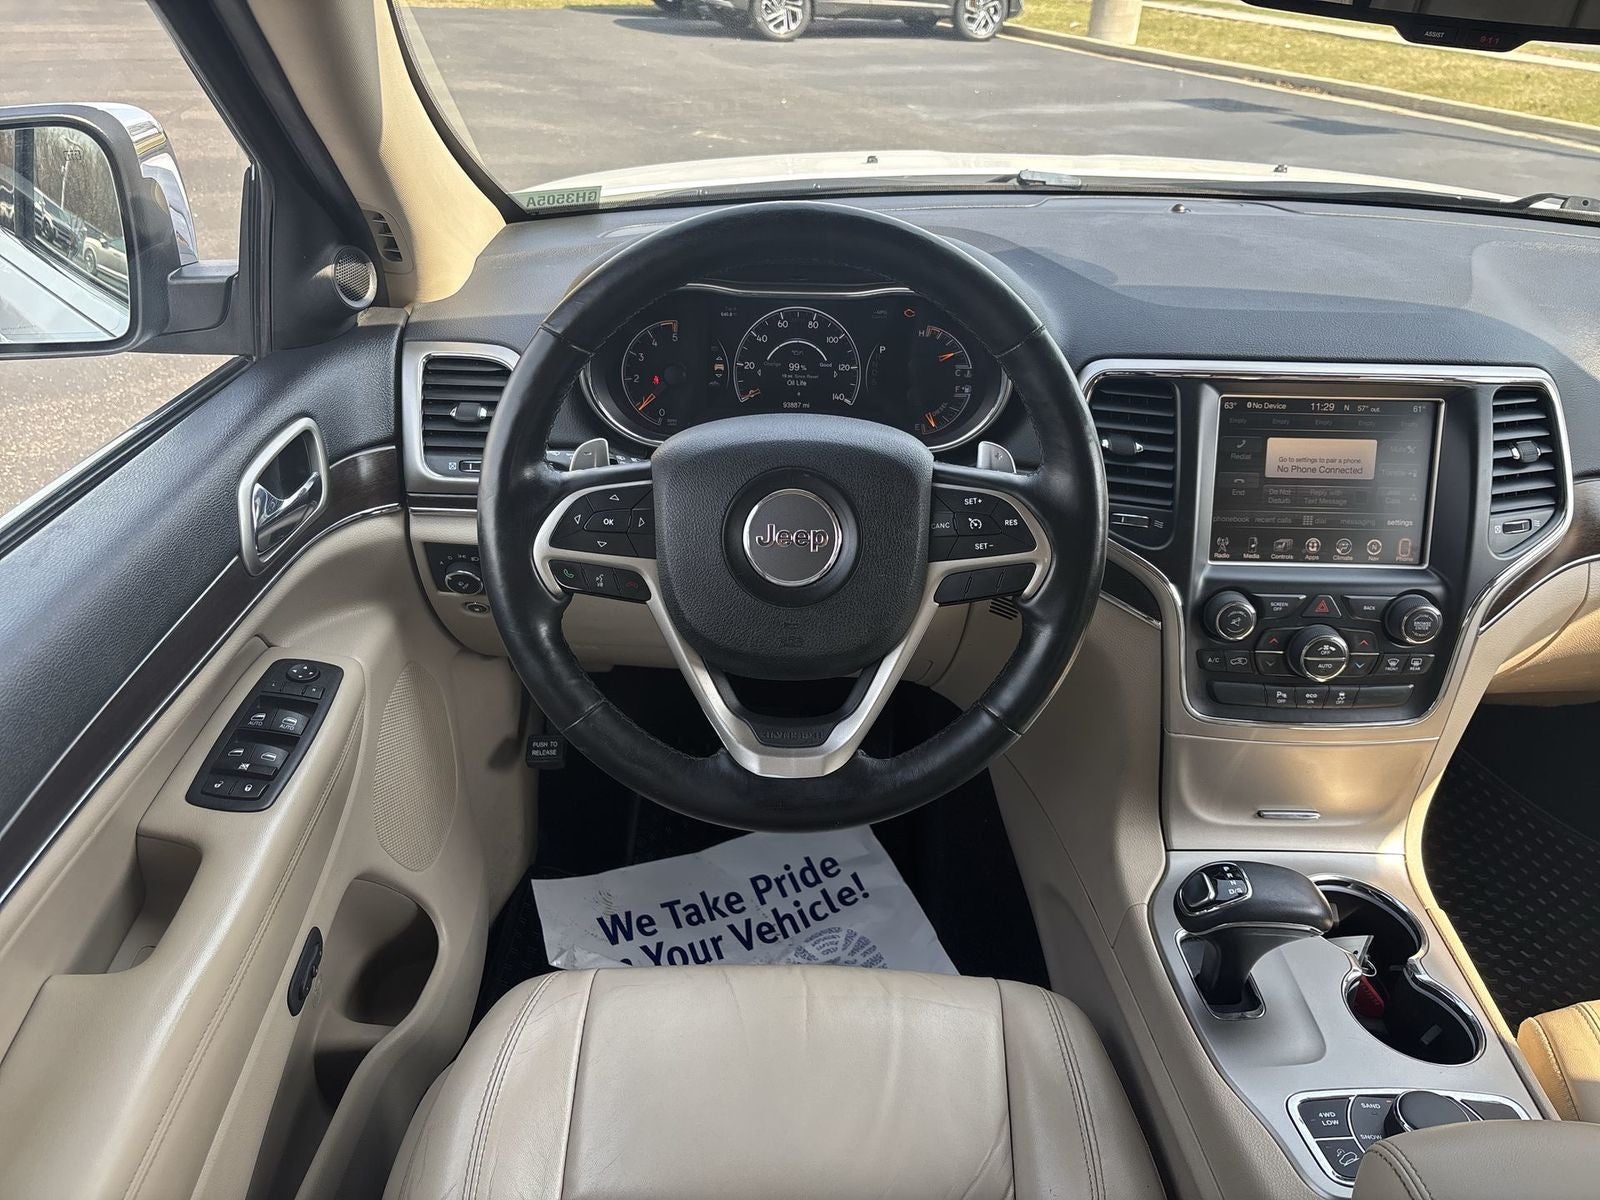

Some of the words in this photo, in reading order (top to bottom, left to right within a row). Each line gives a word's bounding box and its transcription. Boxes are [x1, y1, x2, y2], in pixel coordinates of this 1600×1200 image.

[778, 320, 789, 329] 60
[808, 321, 819, 330] 80
[672, 333, 678, 342] 5
[757, 334, 768, 343] 40
[826, 336, 839, 344] 100
[639, 353, 644, 361] 3
[744, 362, 755, 370] 20
[838, 364, 850, 372] 120
[955, 369, 961, 377] C
[633, 375, 640, 383] 2
[832, 393, 845, 401] 140
[1263, 402, 1287, 410] Device
[1310, 403, 1335, 411] 11:29
[658, 409, 666, 417] 0
[1291, 465, 1317, 473] Phone
[1319, 465, 1363, 474] Connected
[603, 518, 614, 526] OK
[1387, 519, 1414, 527] settings
[755, 523, 829, 553] Jeep
[597, 911, 658, 946] We
[660, 891, 747, 930] Take
[750, 856, 842, 906] Pride
[639, 934, 726, 967] Your
[727, 872, 871, 952] Vehicle!
